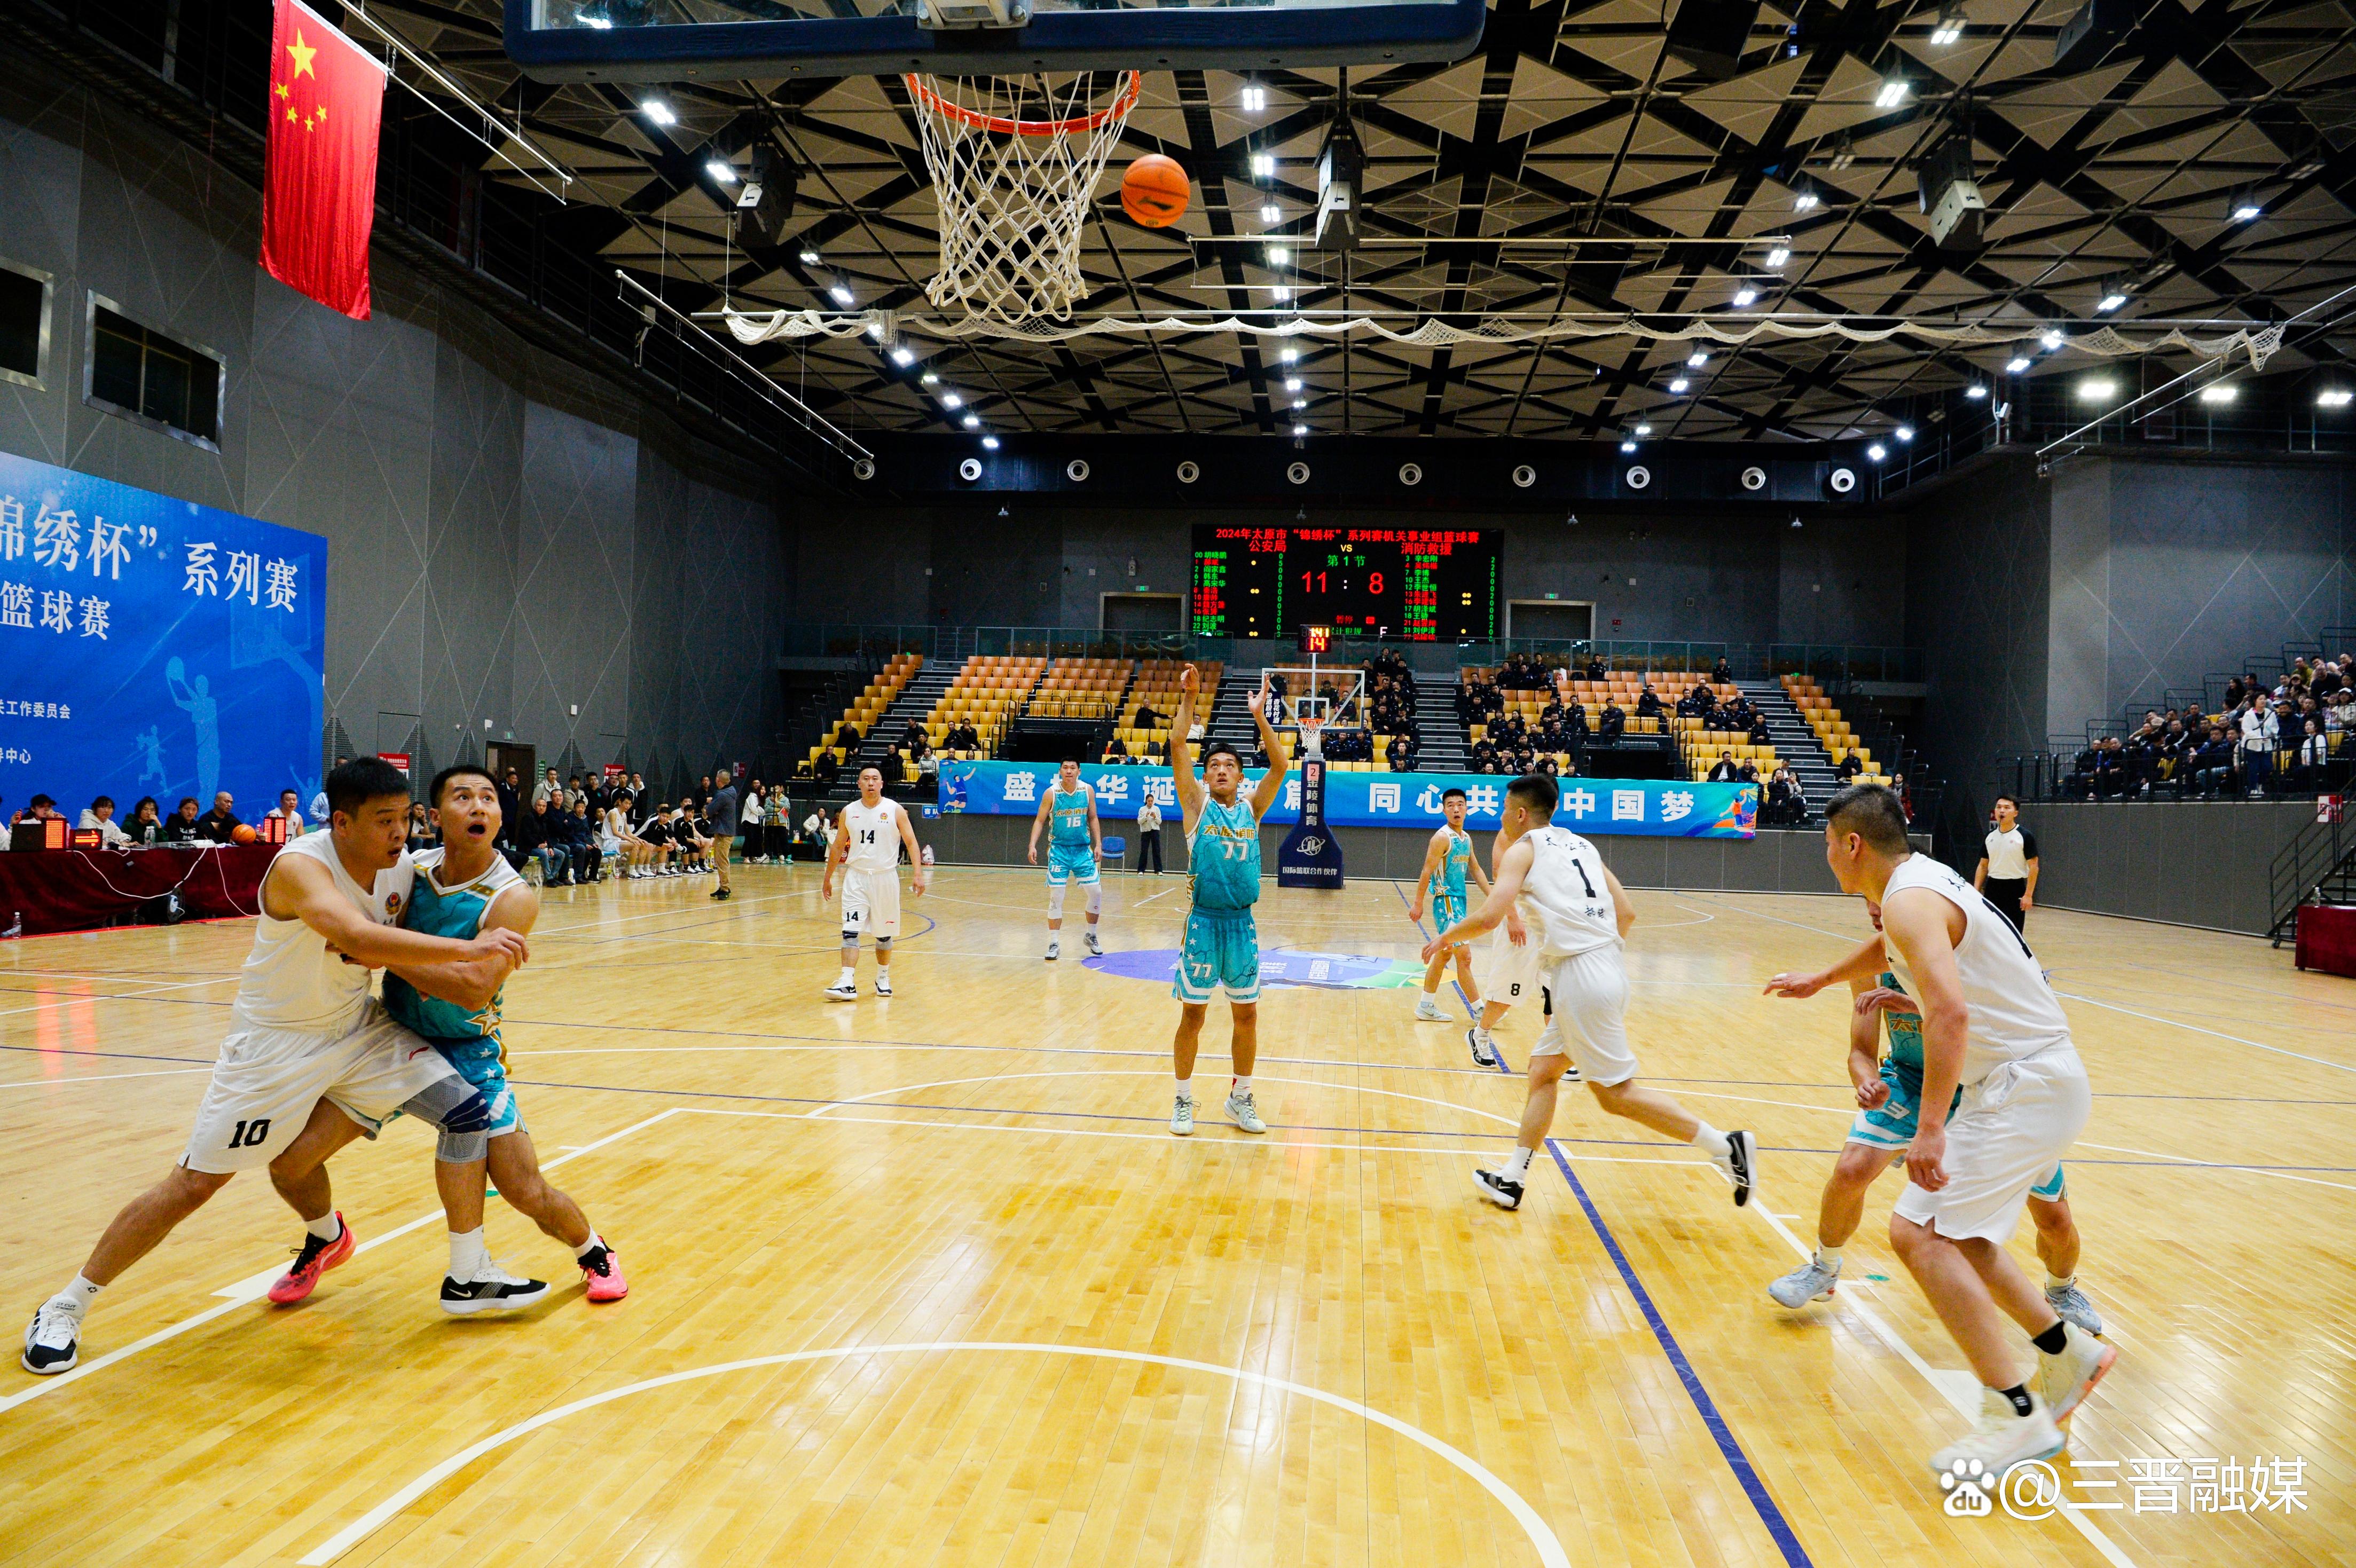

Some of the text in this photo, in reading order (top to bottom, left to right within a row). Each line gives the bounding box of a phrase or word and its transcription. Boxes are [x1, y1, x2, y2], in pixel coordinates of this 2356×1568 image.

[1249, 540, 1286, 552] 公安局
[1401, 542, 1452, 555] 消防救援
[1302, 571, 1327, 593] 11
[1369, 572, 1384, 594] 8
[0, 580, 111, 641] 篮球赛
[1310, 637, 1324, 650] 14
[1310, 768, 1316, 777] 2
[1306, 781, 1319, 826] 金陵体育
[1066, 817, 1081, 828] 16
[860, 830, 875, 844] 14
[1203, 825, 1255, 840] 太原消防
[1221, 841, 1247, 861] 77
[1051, 864, 1062, 872] 16
[1283, 866, 1338, 876] 国际篮联合作伙伴
[1572, 858, 1597, 898] 1
[846, 911, 859, 922] 14
[1190, 962, 1212, 978] 77
[1511, 983, 1520, 996] 8
[228, 1119, 272, 1149] 10
